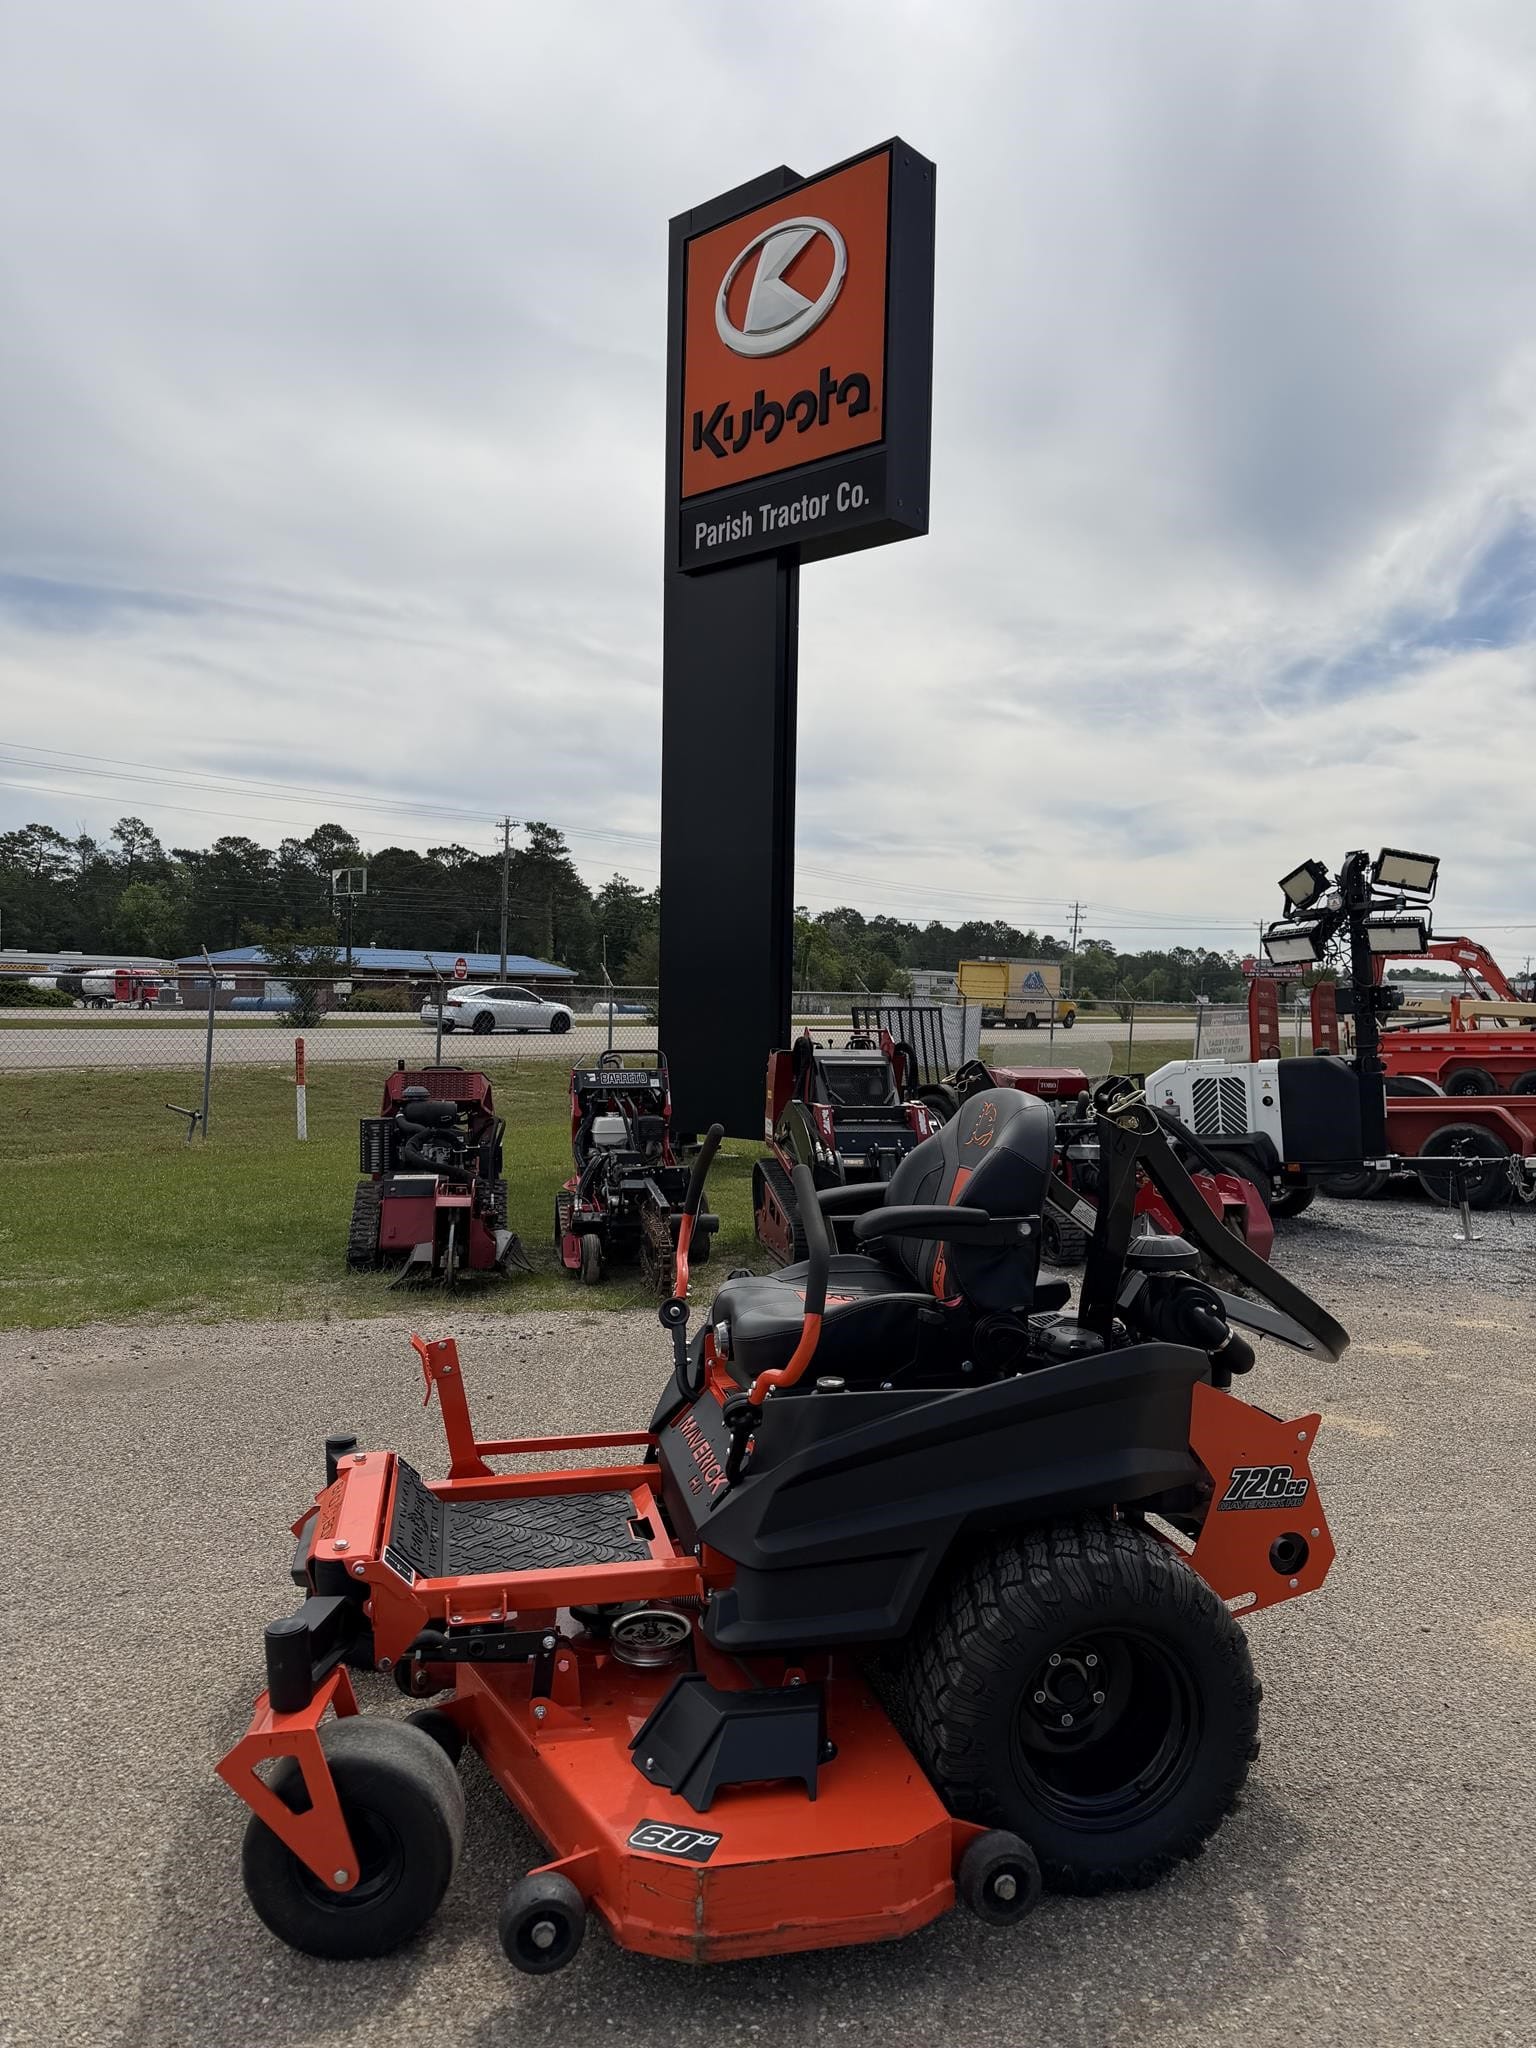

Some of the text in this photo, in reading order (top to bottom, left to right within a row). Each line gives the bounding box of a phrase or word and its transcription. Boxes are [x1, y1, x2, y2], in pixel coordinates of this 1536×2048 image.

[692, 366, 871, 459] Kubota
[695, 481, 870, 550] Parish Tractor Co.
[600, 1072, 649, 1085] BARRETO
[680, 1415, 730, 1495] MAVERICK
[1218, 1498, 1304, 1511] MAVERICK HD
[629, 1825, 720, 1853] 60"
